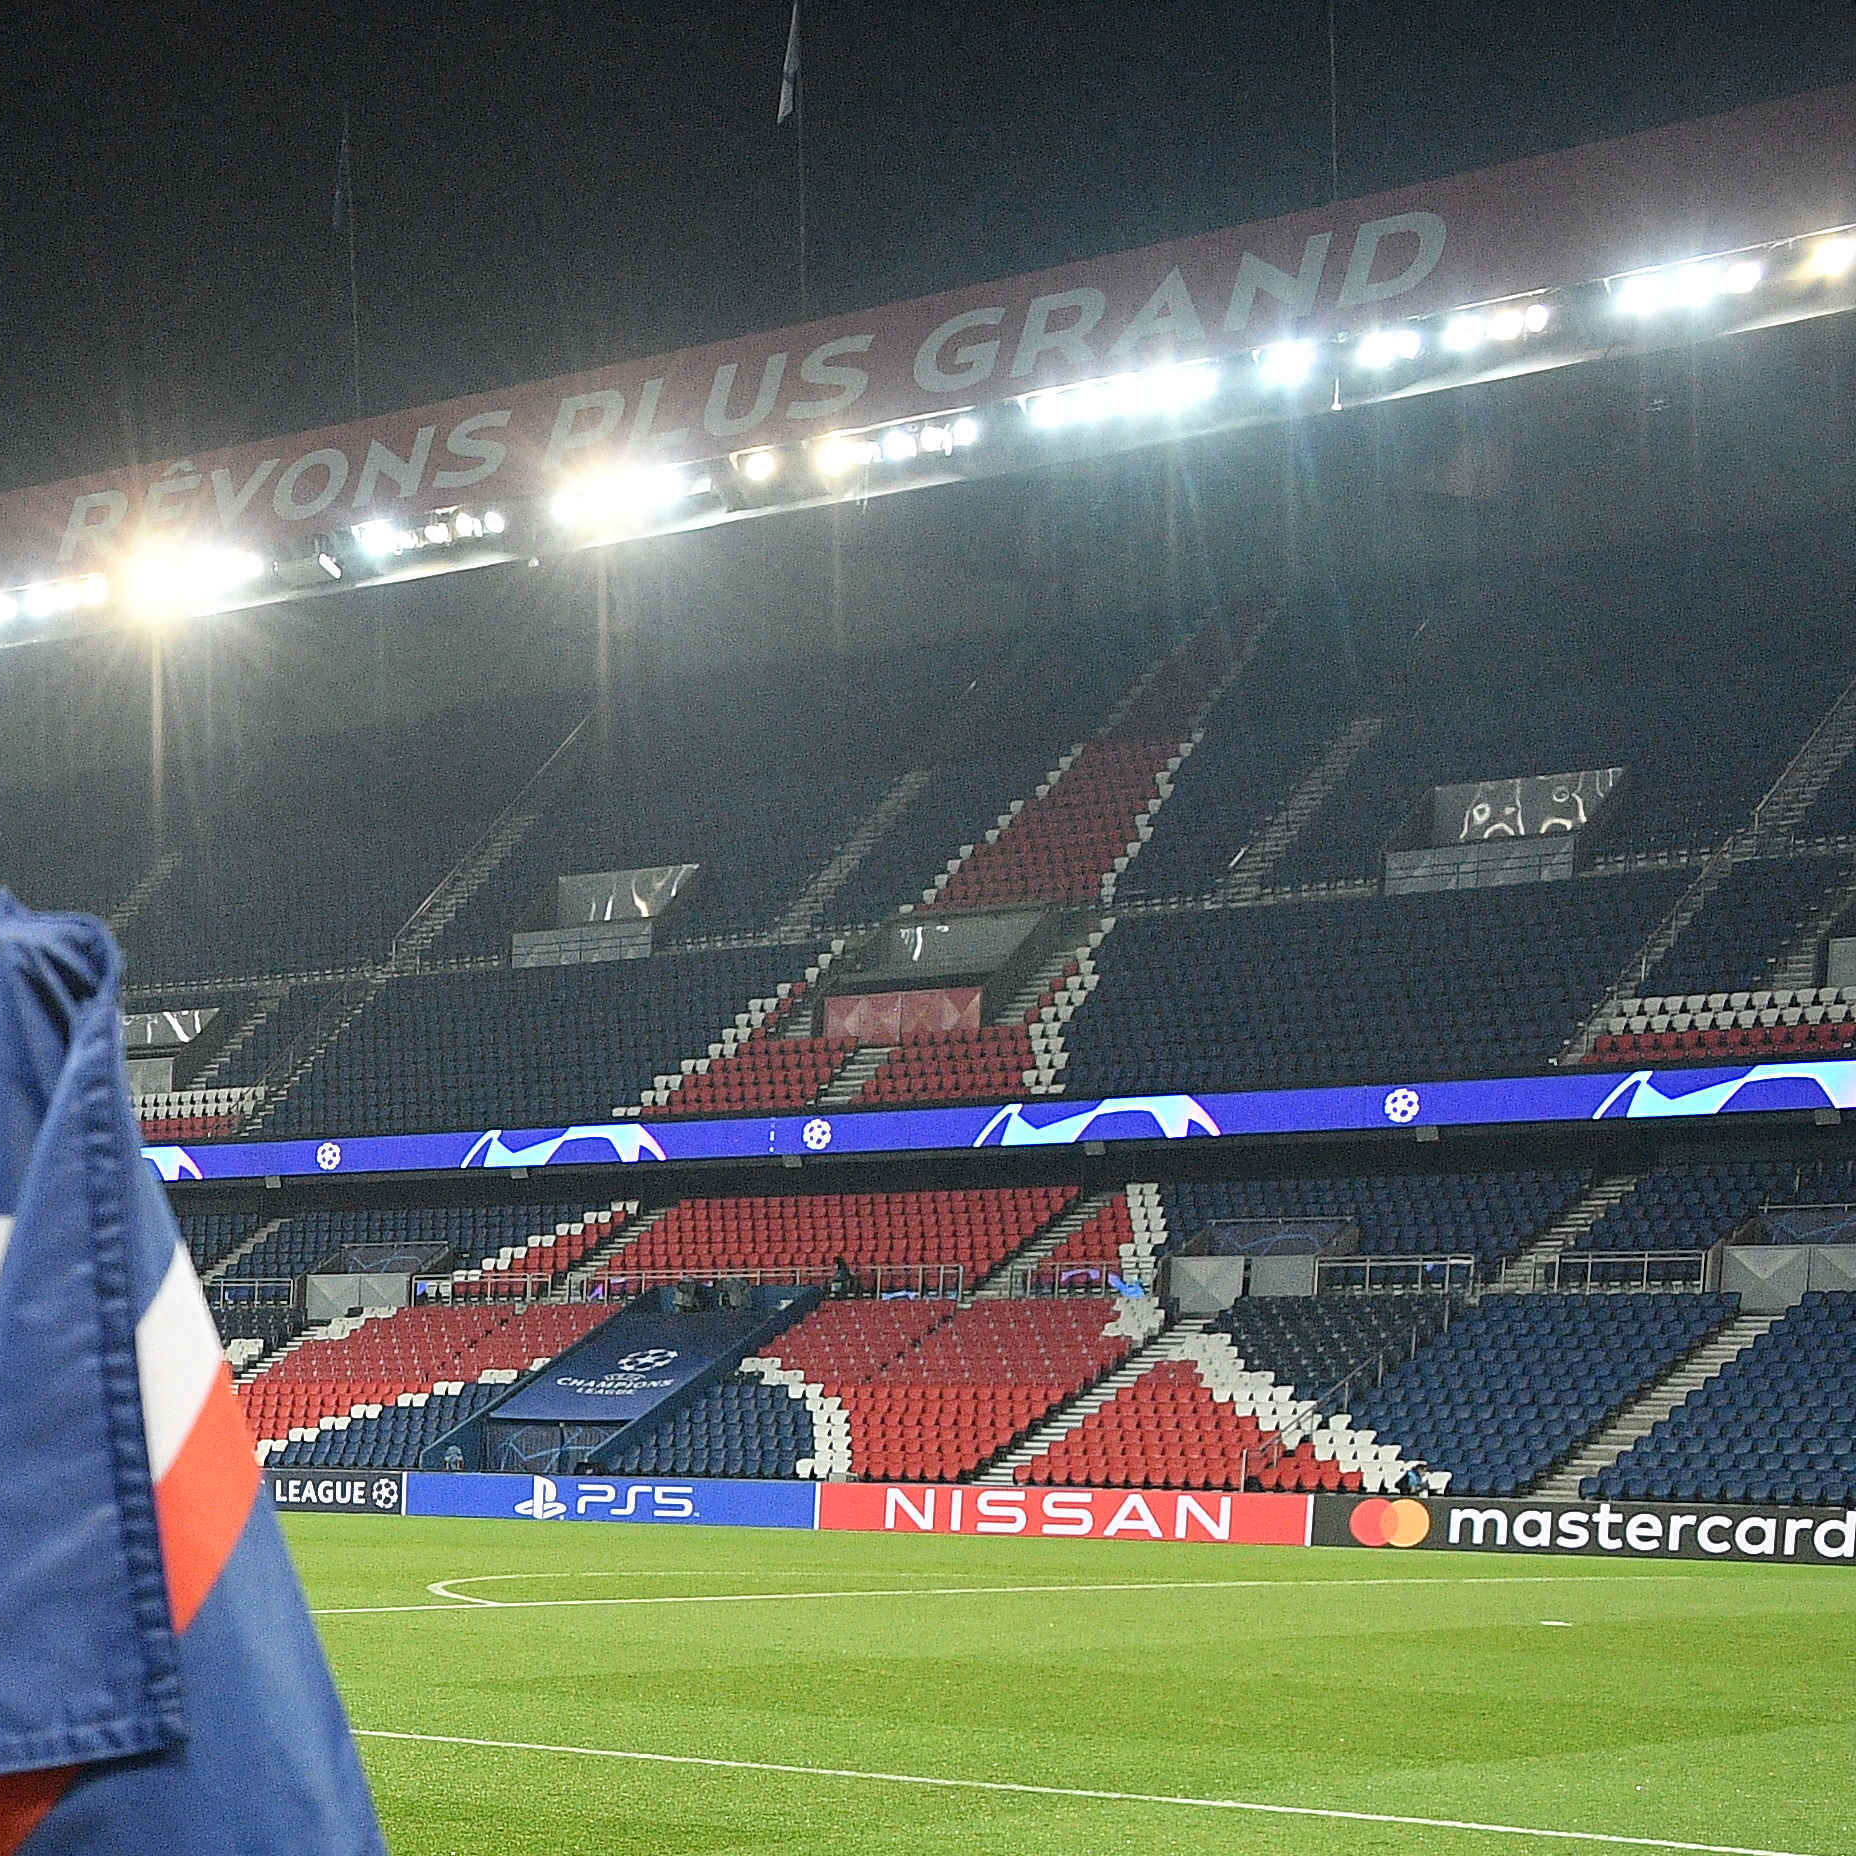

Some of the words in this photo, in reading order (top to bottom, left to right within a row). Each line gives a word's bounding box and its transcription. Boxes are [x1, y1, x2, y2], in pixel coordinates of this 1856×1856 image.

[56, 411, 512, 563] RÊVONS
[540, 334, 874, 472] PLUS
[912, 212, 1447, 392] GRAND
[556, 1377, 674, 1389] CHAMPIONS
[275, 1479, 366, 1504] LEAGUE
[577, 1483, 694, 1517] PS5
[885, 1486, 1234, 1541] NISSAN
[1447, 1503, 1856, 1559] mastercard
